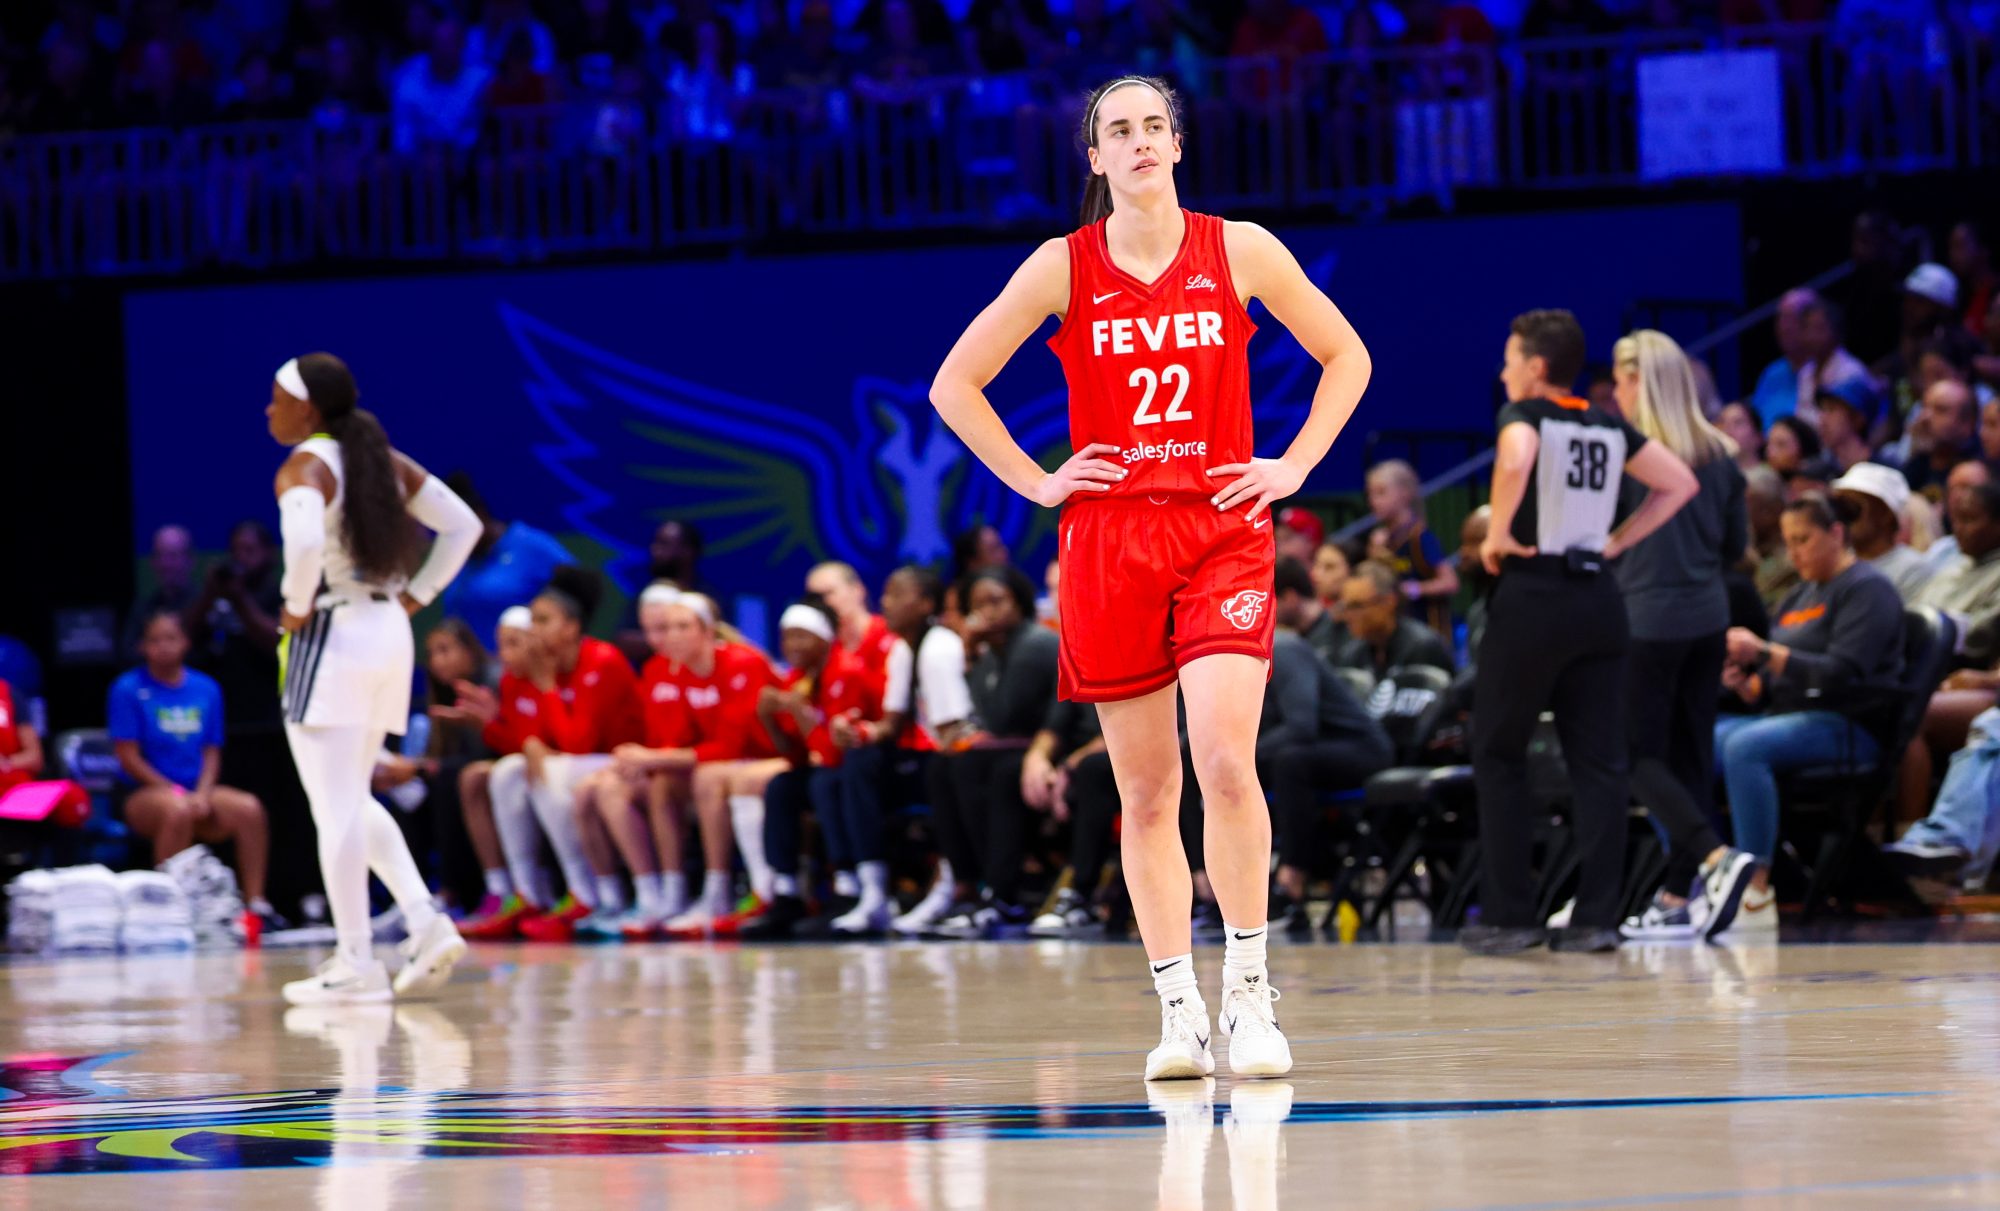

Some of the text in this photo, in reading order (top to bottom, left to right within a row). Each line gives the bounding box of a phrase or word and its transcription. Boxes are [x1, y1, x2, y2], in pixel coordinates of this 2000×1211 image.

[1185, 274, 1217, 292] Lilly
[1092, 311, 1225, 356] FEVER
[1128, 364, 1193, 426] 22
[1122, 438, 1207, 464] salesforce
[1567, 439, 1608, 491] 38
